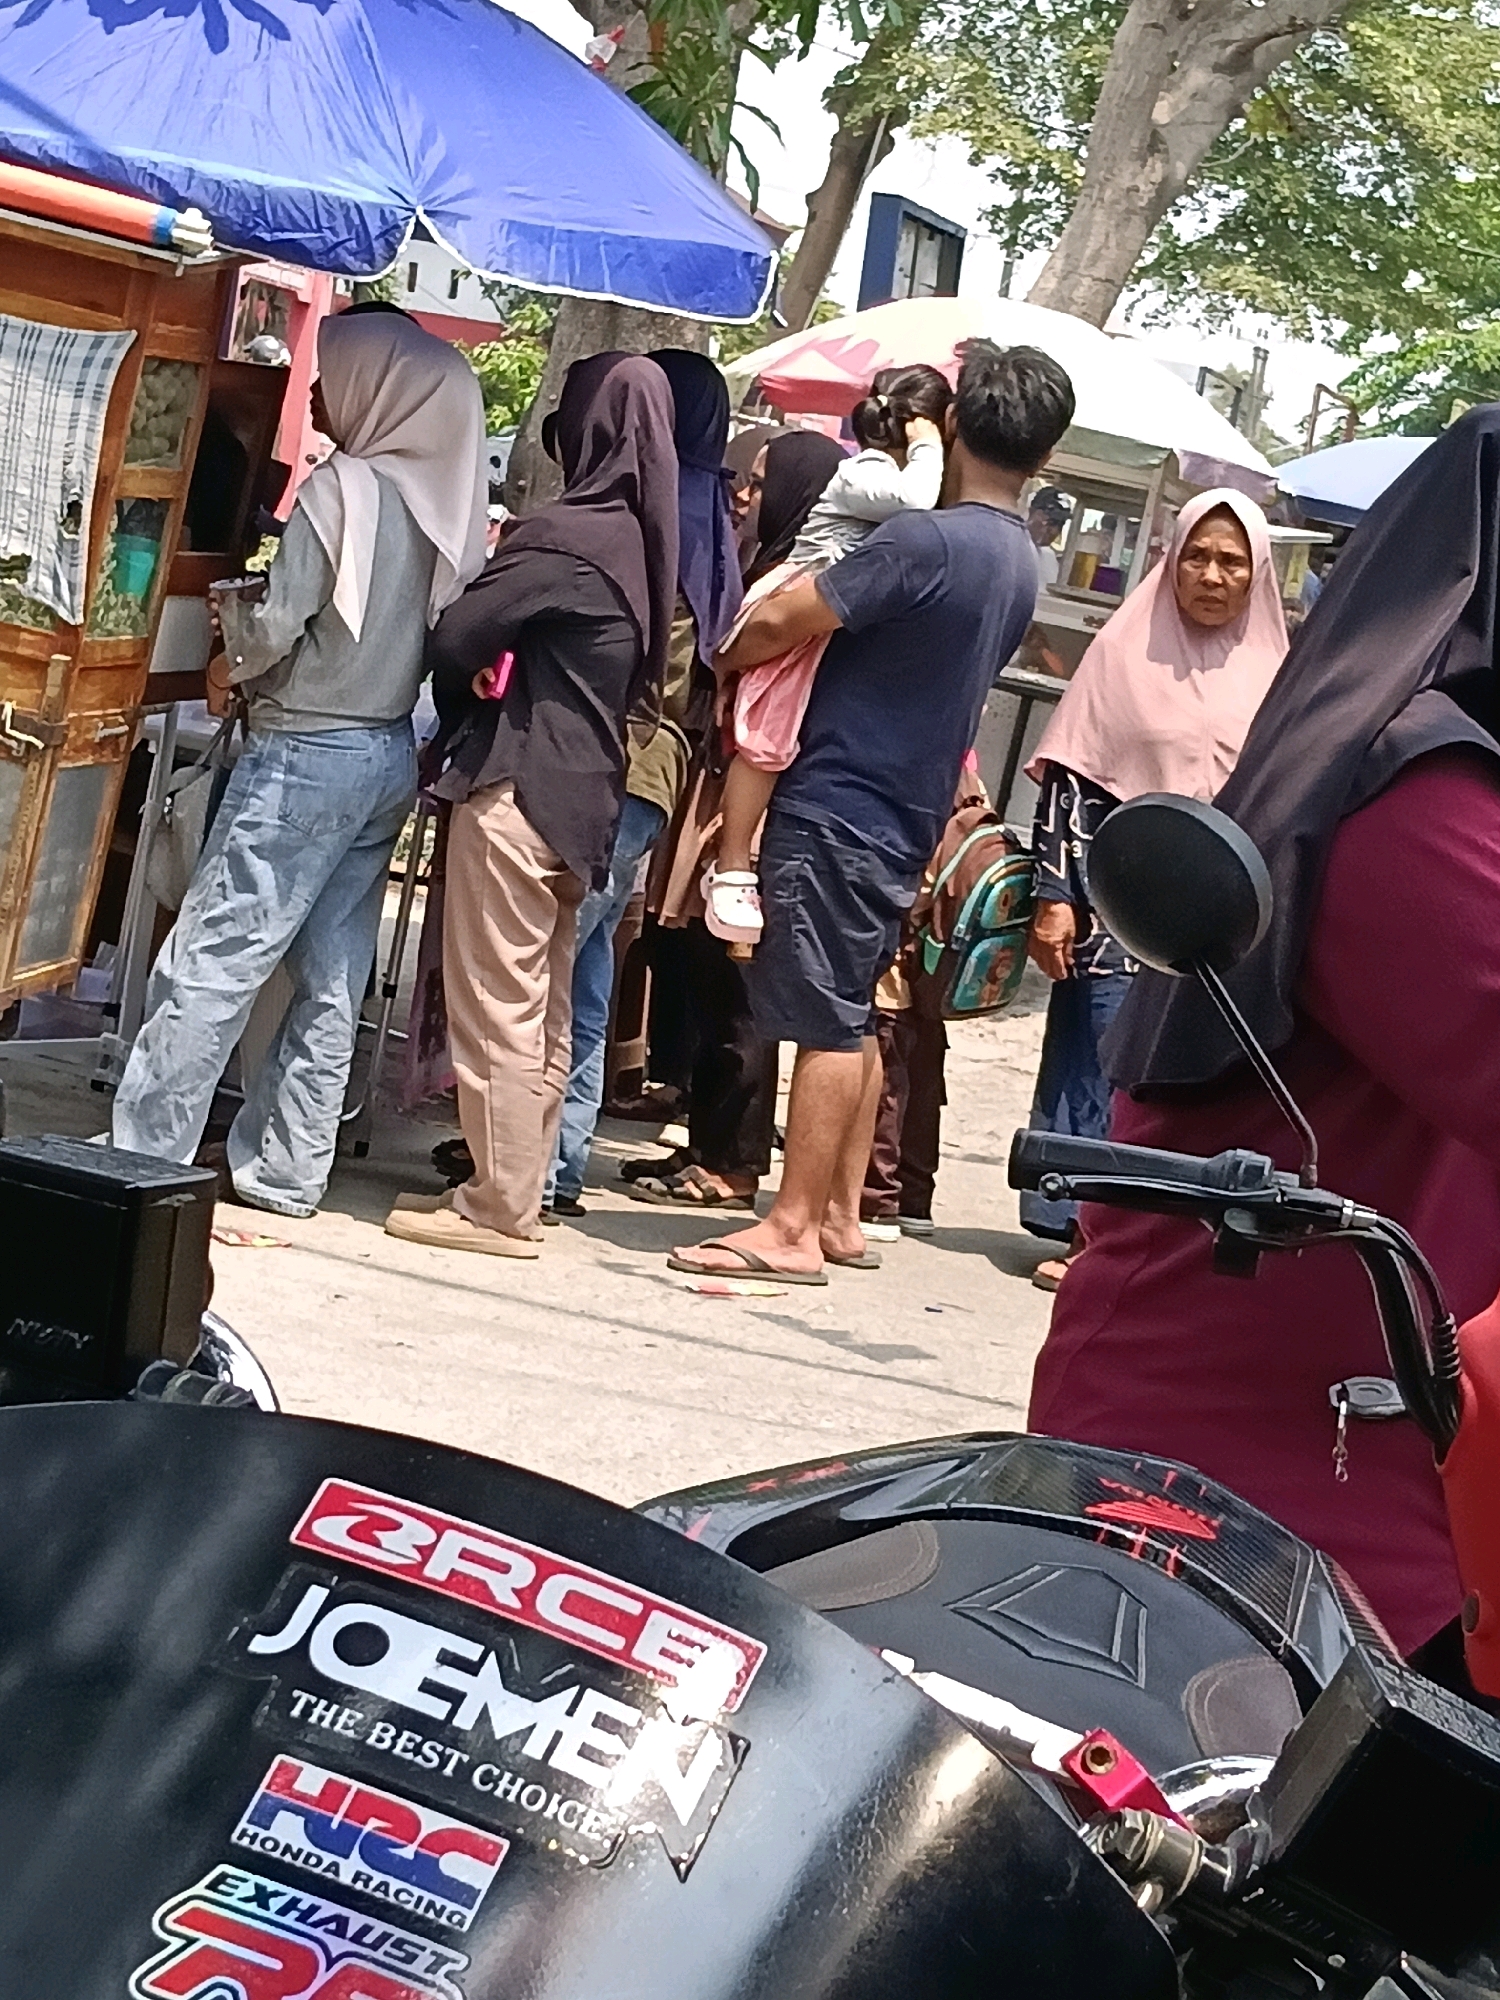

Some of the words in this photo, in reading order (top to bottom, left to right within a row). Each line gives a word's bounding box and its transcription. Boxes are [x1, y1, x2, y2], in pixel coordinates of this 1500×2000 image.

[248, 1584, 728, 1827] JOEMEN
[290, 1690, 361, 1734] THE
[367, 1720, 470, 1778] BEST
[472, 1763, 610, 1840] CHOICE
[204, 1870, 457, 1977] EXHAUST
[236, 1827, 341, 1882] HONDA
[351, 1869, 468, 1928] RACING
